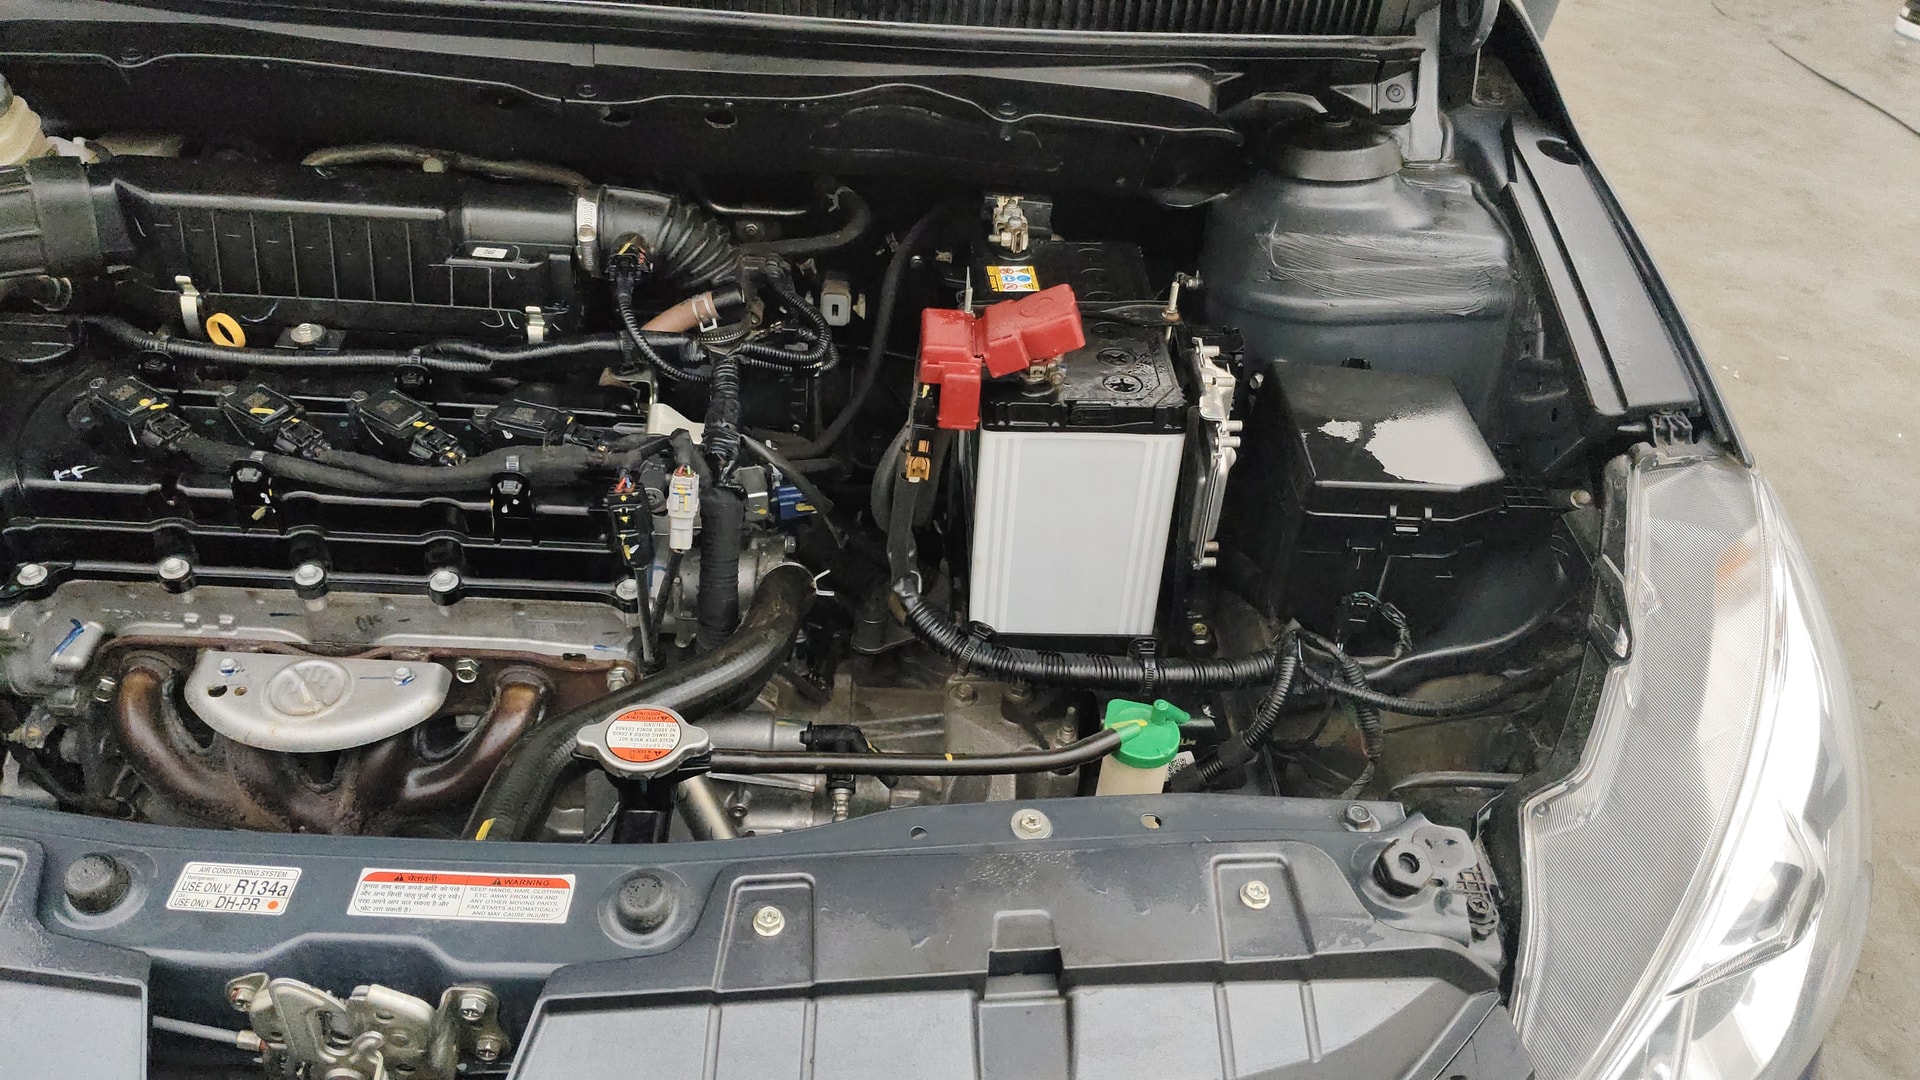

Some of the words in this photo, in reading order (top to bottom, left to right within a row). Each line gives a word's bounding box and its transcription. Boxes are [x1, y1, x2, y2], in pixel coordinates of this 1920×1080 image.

[212, 867, 259, 876] CONDITIONING
[408, 873, 438, 882] चेतावनी
[182, 881, 203, 892] USE
[203, 882, 231, 893] ONLY
[234, 879, 288, 896] R134a
[174, 898, 191, 906] USE
[190, 899, 212, 907] ONLY
[215, 895, 260, 910] DH-PR
